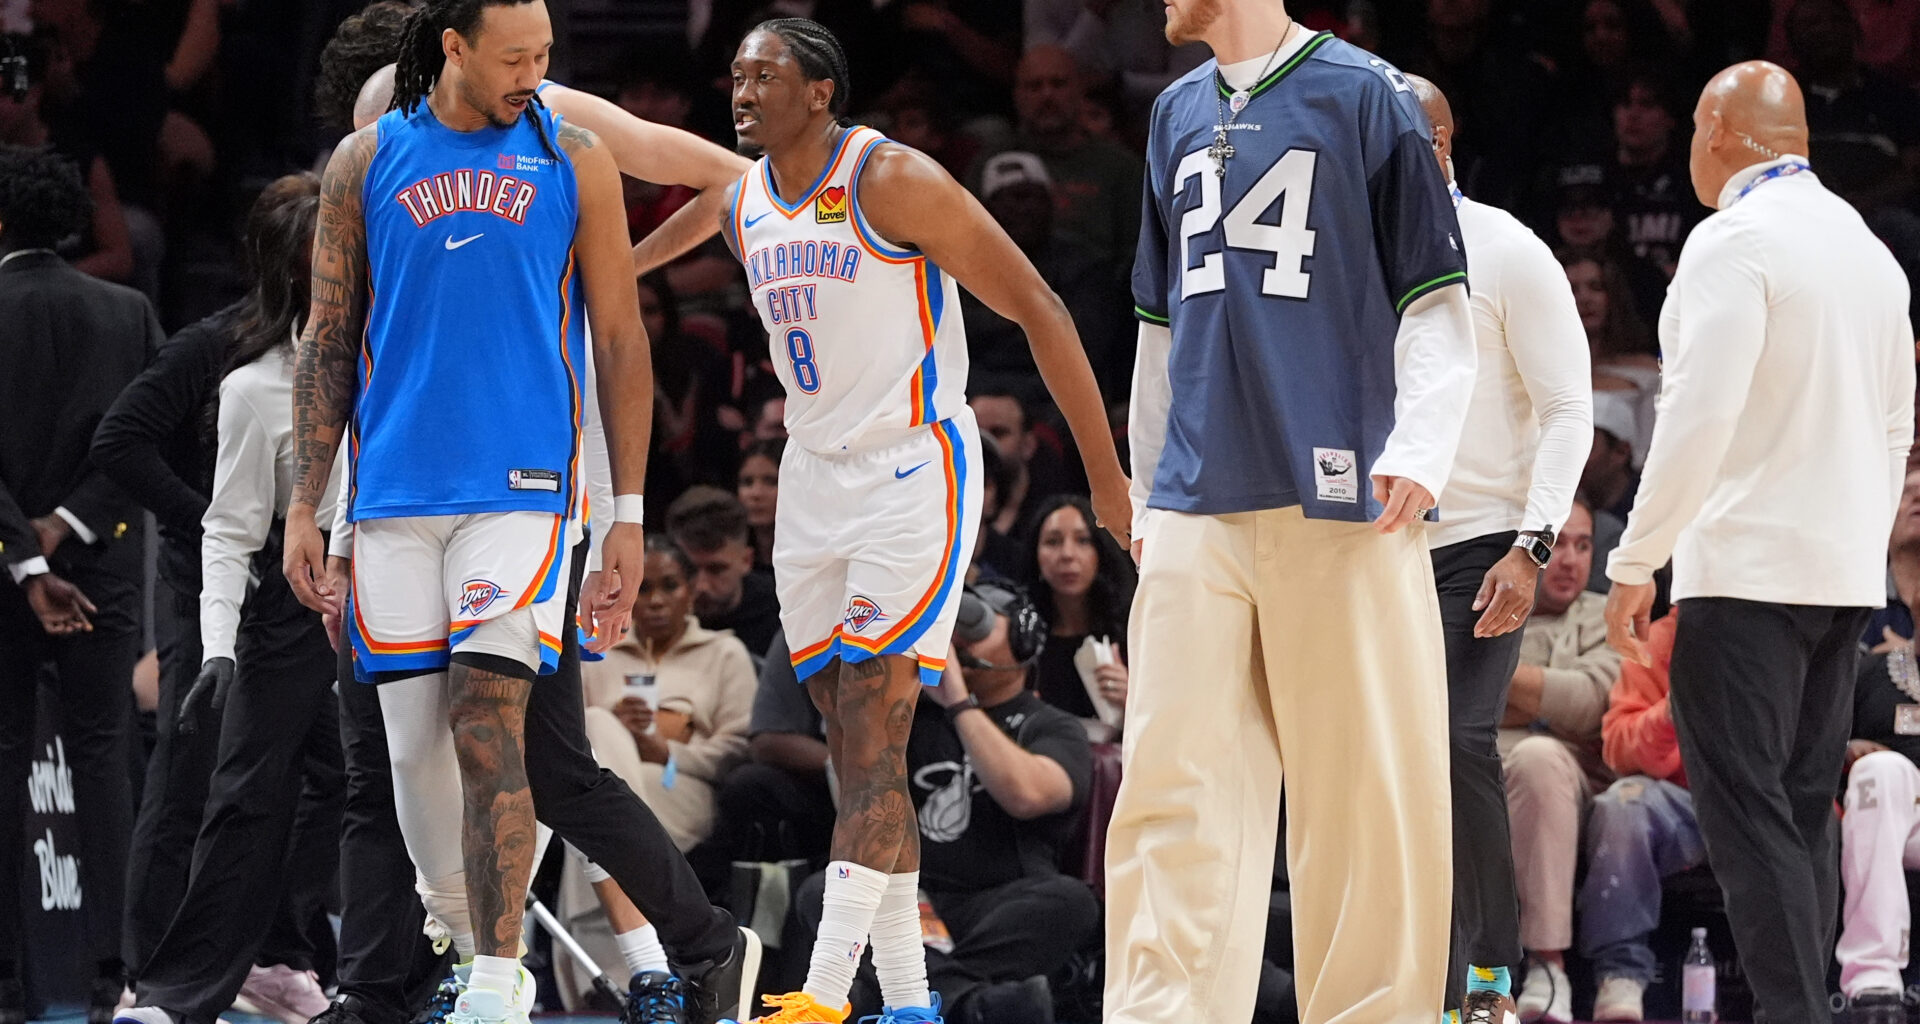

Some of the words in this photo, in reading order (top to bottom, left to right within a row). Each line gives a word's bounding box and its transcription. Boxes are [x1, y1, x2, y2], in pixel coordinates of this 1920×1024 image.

[1369, 59, 1417, 97] 2
[516, 162, 539, 171] BANK
[396, 169, 537, 228] THUNDER
[1173, 147, 1317, 301] 24
[767, 284, 817, 324] CITY
[784, 327, 822, 395] 8
[462, 587, 491, 607] OKC
[846, 605, 873, 620] OKC
[34, 827, 82, 911] Blue
